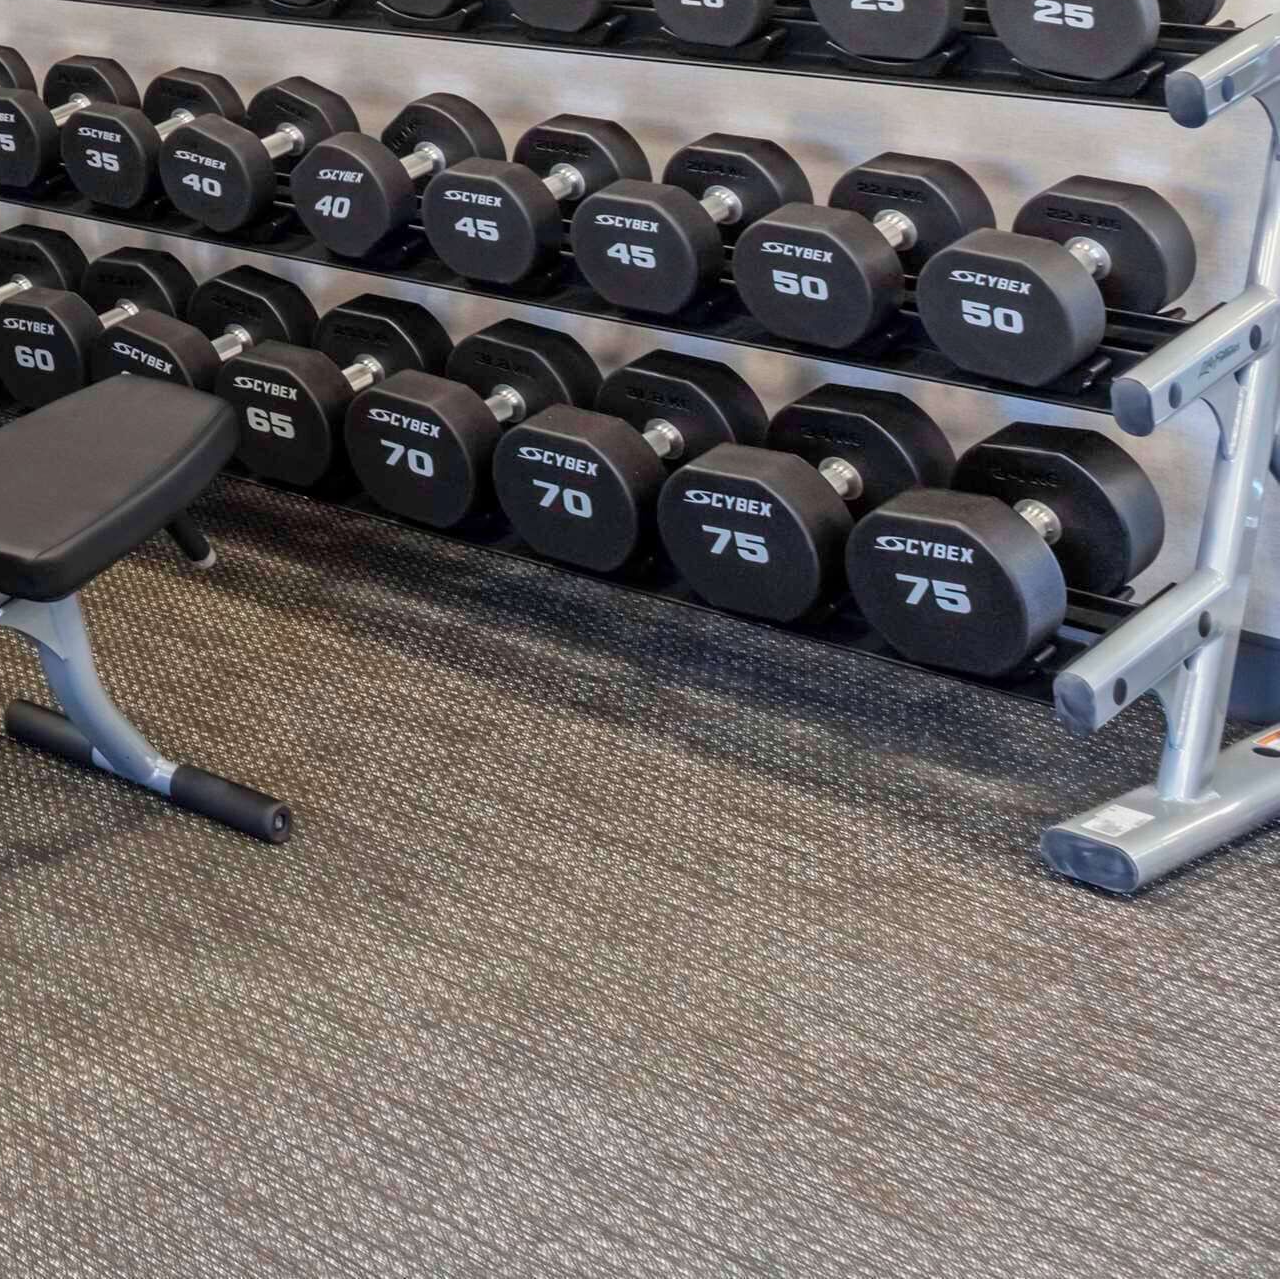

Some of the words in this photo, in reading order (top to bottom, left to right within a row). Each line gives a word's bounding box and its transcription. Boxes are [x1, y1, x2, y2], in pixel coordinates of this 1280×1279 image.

[1032, 0, 1096, 30] 25
[92, 129, 122, 144] CYBEX
[85, 149, 120, 172] 35
[189, 152, 227, 171] CYBEX
[182, 173, 222, 198] 40
[331, 169, 364, 184] CYBEX
[314, 195, 352, 219] 40
[460, 191, 503, 208] CYBEX
[454, 216, 500, 242] 45
[613, 216, 659, 233] CYBEX
[606, 242, 657, 270] 45
[782, 245, 834, 264] CYBEX
[771, 269, 829, 301] 50
[974, 273, 1032, 296] CYBEX
[18, 319, 55, 336] CYBEX
[960, 299, 1025, 335] 50
[14, 345, 56, 372] 60
[131, 346, 173, 376] CYBEX
[253, 380, 298, 401] CYBEX
[246, 406, 296, 440] 65
[390, 413, 441, 439] CYBEX
[379, 439, 435, 478] 70
[543, 452, 599, 478] CYBEX
[532, 479, 593, 519] 70
[711, 493, 773, 518] CYBEX
[701, 524, 770, 565] 75
[905, 539, 974, 565] CYBEX
[894, 573, 972, 615] 75
